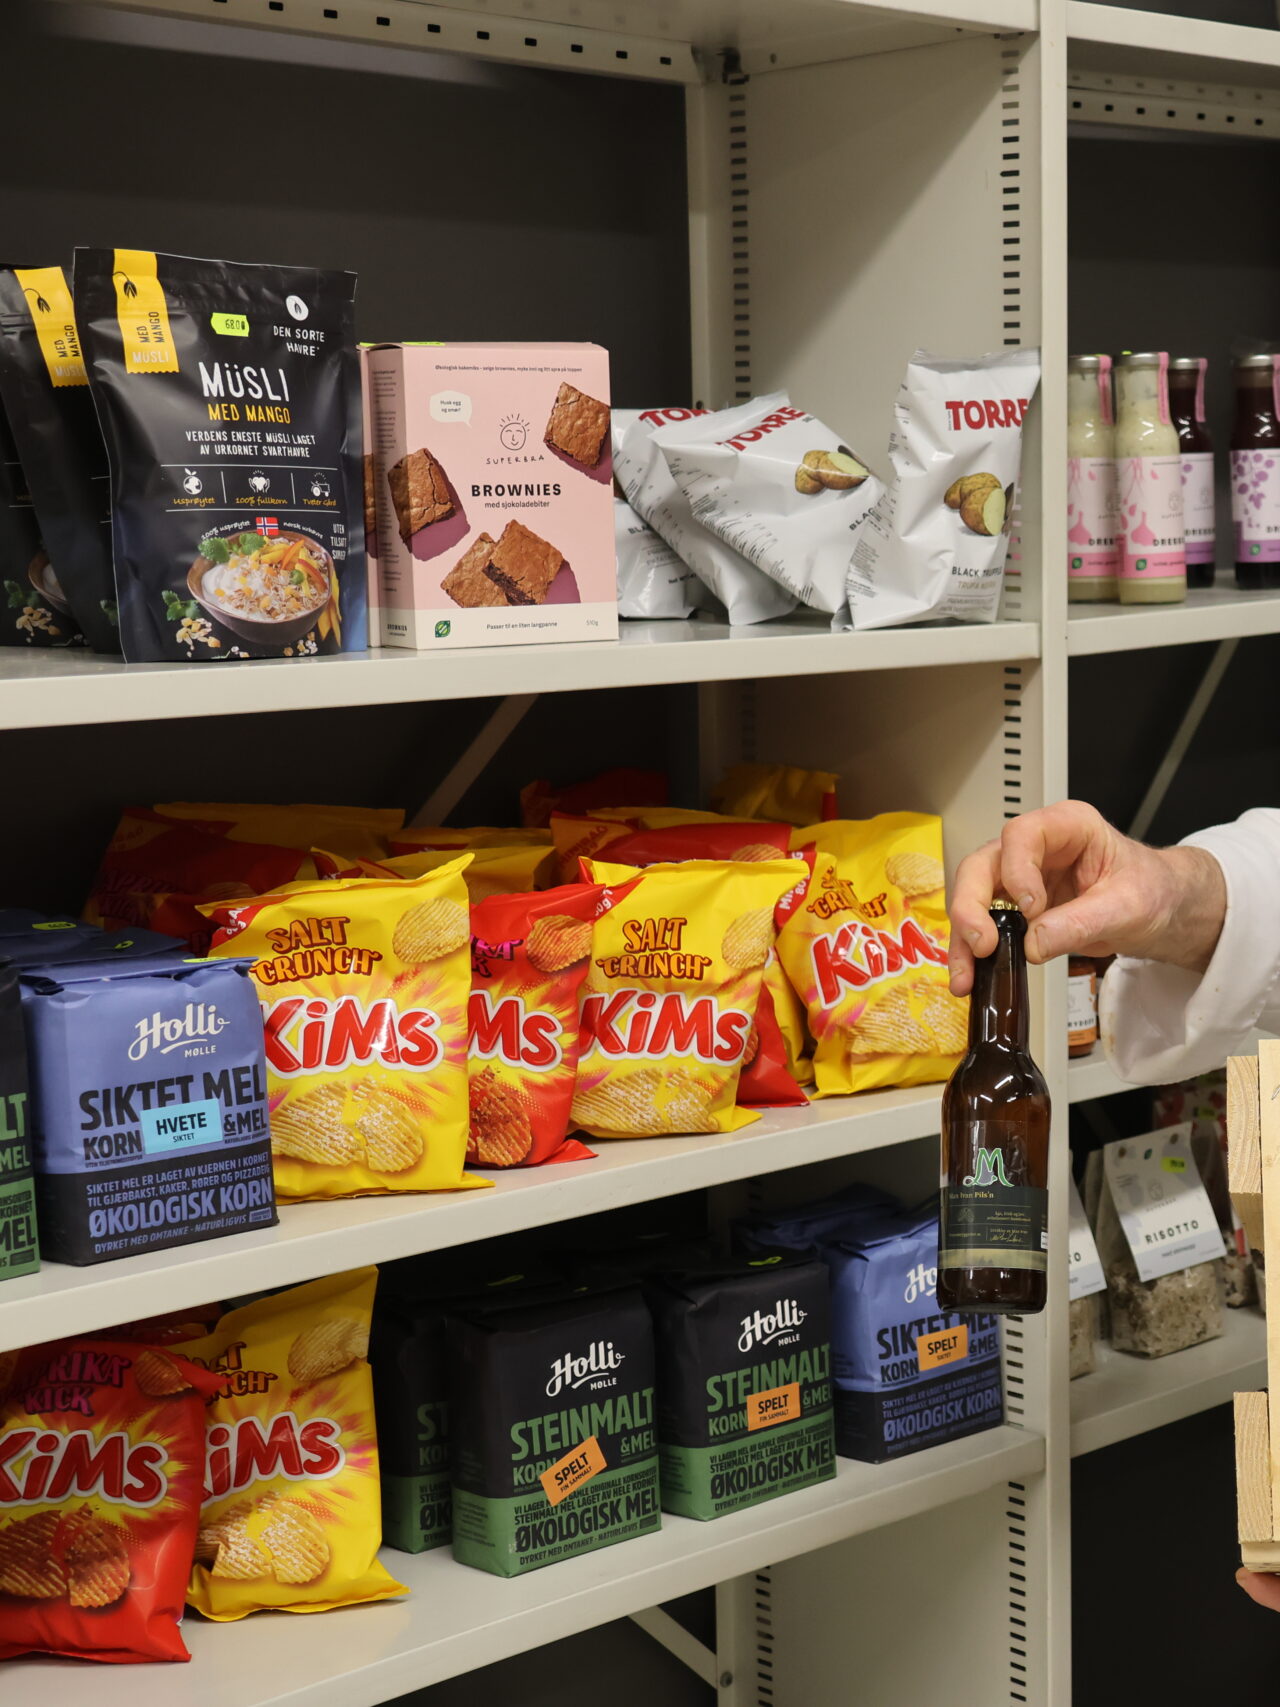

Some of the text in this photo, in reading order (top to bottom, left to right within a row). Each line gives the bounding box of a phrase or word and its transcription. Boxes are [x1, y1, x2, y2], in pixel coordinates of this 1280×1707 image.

[136, 325, 149, 343] MED
[148, 311, 165, 343] MANGO
[273, 325, 325, 342] DEN SORTE
[198, 361, 290, 402] MÜSLI
[207, 403, 291, 424] MED MANGO
[185, 430, 316, 445] VERDENS ENESTE MÜSLI LAGET
[200, 444, 311, 458] AV URKORNET SVARTHAVRE
[486, 455, 545, 465] SUPERBRA
[471, 483, 562, 497] BROWNIES
[501, 500, 550, 509] sjokoladebiter
[951, 566, 980, 578] BLACK
[265, 916, 350, 955] SALT
[622, 917, 687, 953] SALT
[250, 947, 382, 986] CRUNCH
[595, 951, 712, 981] CRUNCH
[128, 1003, 230, 1061] Holli
[184, 1045, 217, 1058] MØLLE
[79, 1074, 194, 1131] SIKTET
[202, 1064, 265, 1107] MEL
[156, 1112, 208, 1136] HVETE
[172, 1133, 195, 1143] SIKTET
[83, 1130, 143, 1161] KORN
[86, 1182, 120, 1196] SIKTET
[122, 1178, 141, 1190] MEL
[142, 1176, 154, 1186] ER
[156, 1170, 183, 1183] LAGET
[185, 1166, 196, 1177] AV
[198, 1159, 236, 1176] KJERNEN
[243, 1152, 269, 1167] KORNET
[88, 1197, 102, 1208] TIL
[192, 1176, 220, 1190] RØRER
[221, 1173, 233, 1184] OG
[89, 1177, 273, 1238] ØKOLOGISK KORN
[95, 1238, 128, 1254] DYRKET
[130, 1234, 149, 1247] MED
[150, 1227, 189, 1243] OMTANKE
[194, 1215, 247, 1233] NATURLIGVIS
[1145, 1219, 1200, 1244] RISOTTO
[738, 1298, 808, 1352] Holli
[778, 1334, 800, 1347] MØLLE
[928, 1336, 958, 1355] SPELT
[546, 1341, 625, 1397] Holli
[590, 1377, 617, 1391] MØLLE
[706, 1342, 830, 1413] STEINMALT
[881, 1358, 919, 1383] KORN
[758, 1394, 789, 1414] SPELT
[883, 1399, 964, 1441] ØKOLOGISK
[967, 1384, 1002, 1416] KORN
[510, 1387, 654, 1461] STEINMALT
[709, 1409, 748, 1437] KORN
[554, 1452, 589, 1487] SPELT
[711, 1448, 804, 1500] ØKOLOGISK
[807, 1438, 834, 1469] MEL
[514, 1505, 522, 1515] VI
[524, 1500, 545, 1513] LAGER
[515, 1506, 558, 1525] STEINMALT
[561, 1502, 576, 1513] MEL
[578, 1494, 600, 1508] LAGET
[602, 1491, 611, 1500] AV
[613, 1483, 631, 1498] HELE
[516, 1498, 622, 1552] ØKOLOGISK
[626, 1487, 659, 1520] MEL
[520, 1552, 546, 1565] DYRKET
[548, 1547, 562, 1557] MED
